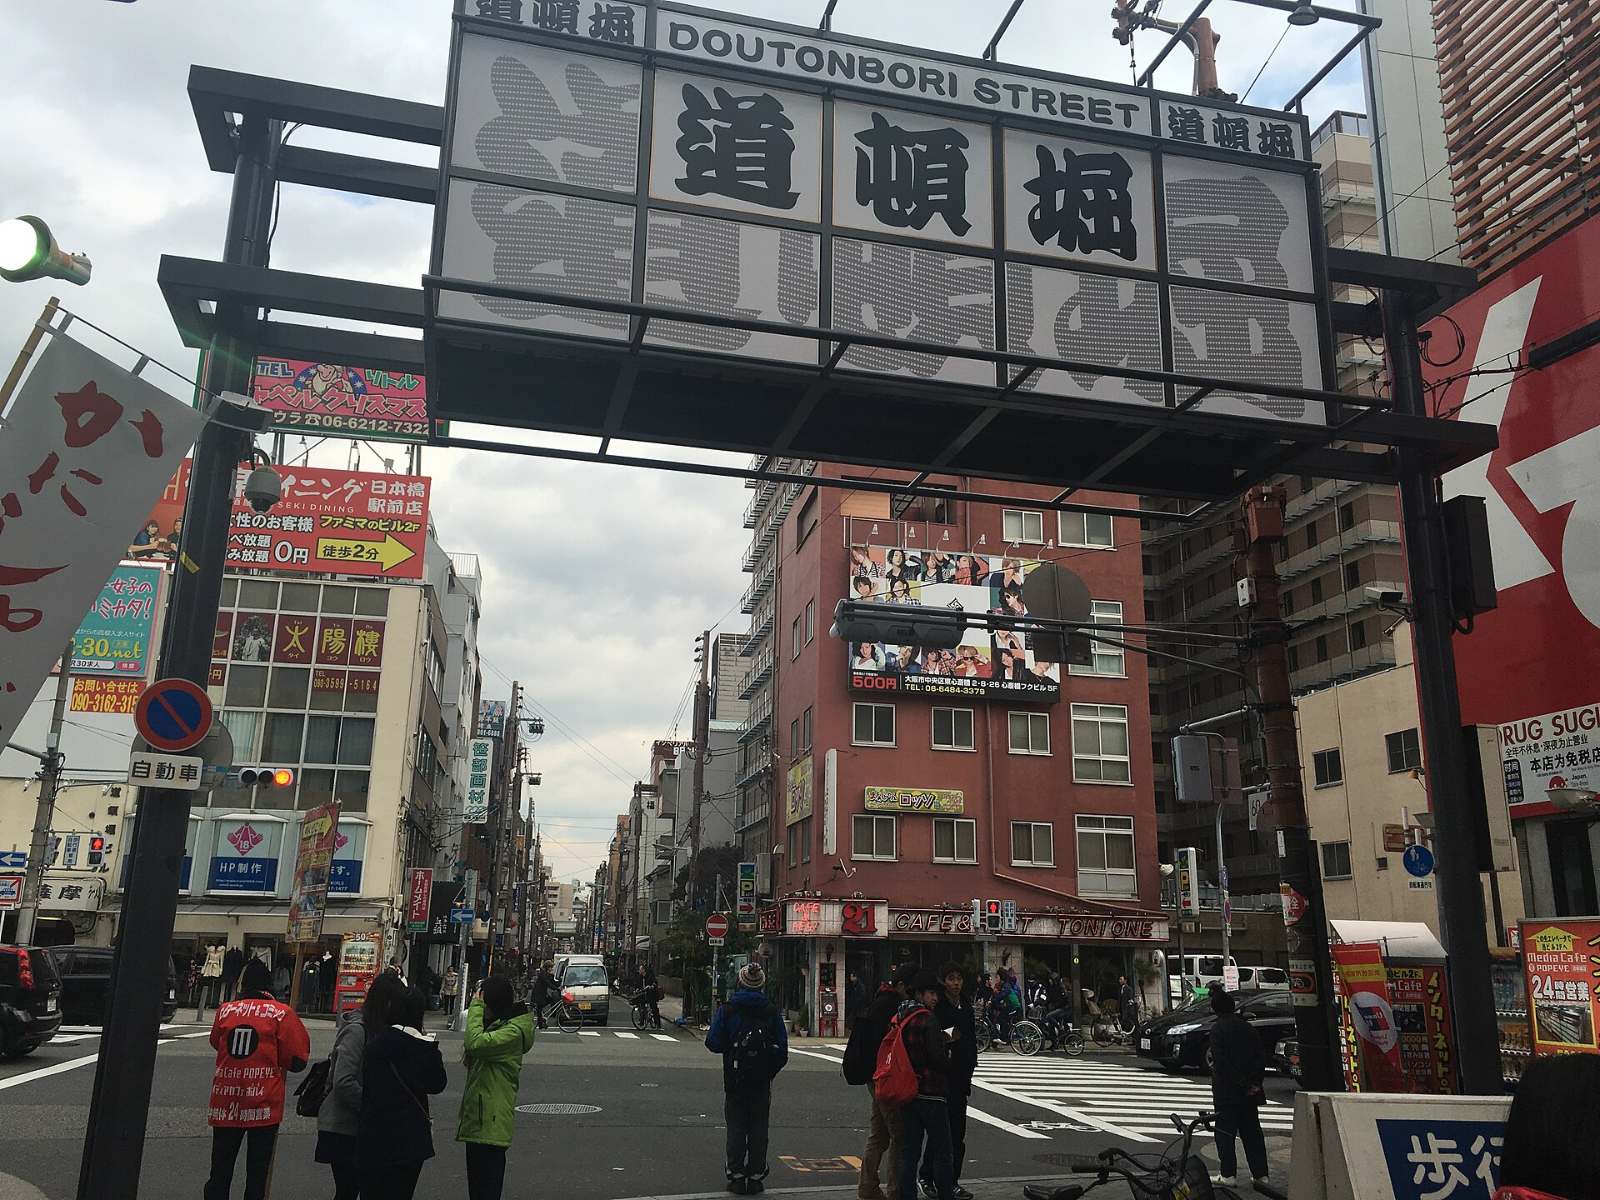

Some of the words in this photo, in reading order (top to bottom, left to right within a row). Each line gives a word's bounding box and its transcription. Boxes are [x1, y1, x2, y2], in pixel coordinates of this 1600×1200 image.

[475, 0, 636, 44] 道頓堀
[668, 22, 957, 98] DOUTONBORI
[974, 77, 1140, 130] STREET
[1168, 105, 1295, 159] 道頓堀
[674, 82, 1137, 262] 道頓堀
[257, 361, 294, 377] TEL
[366, 369, 419, 390] リトル
[322, 415, 430, 435] 06-6212-7322
[278, 474, 367, 503] イニング
[371, 480, 425, 498] 日本橋
[278, 502, 305, 510] SEKI
[310, 504, 354, 514] DINING
[368, 497, 423, 516] 駅前店
[320, 515, 420, 533] ファミマのビル2F
[229, 532, 272, 547] べ放題
[226, 548, 269, 563] み放題
[274, 540, 309, 564] 0円
[323, 544, 380, 561] 徒歩2分
[74, 679, 138, 693] お問い合せは
[853, 675, 897, 690] 500円
[1499, 718, 1543, 746] RUG
[131, 759, 198, 783] 自動車
[740, 880, 754, 896] P
[842, 903, 878, 934] 21
[896, 913, 954, 931] CAFE
[957, 914, 972, 932] &
[1527, 952, 1558, 963] Media
[1560, 952, 1587, 963] Cafe
[1536, 964, 1570, 972] POPEYE
